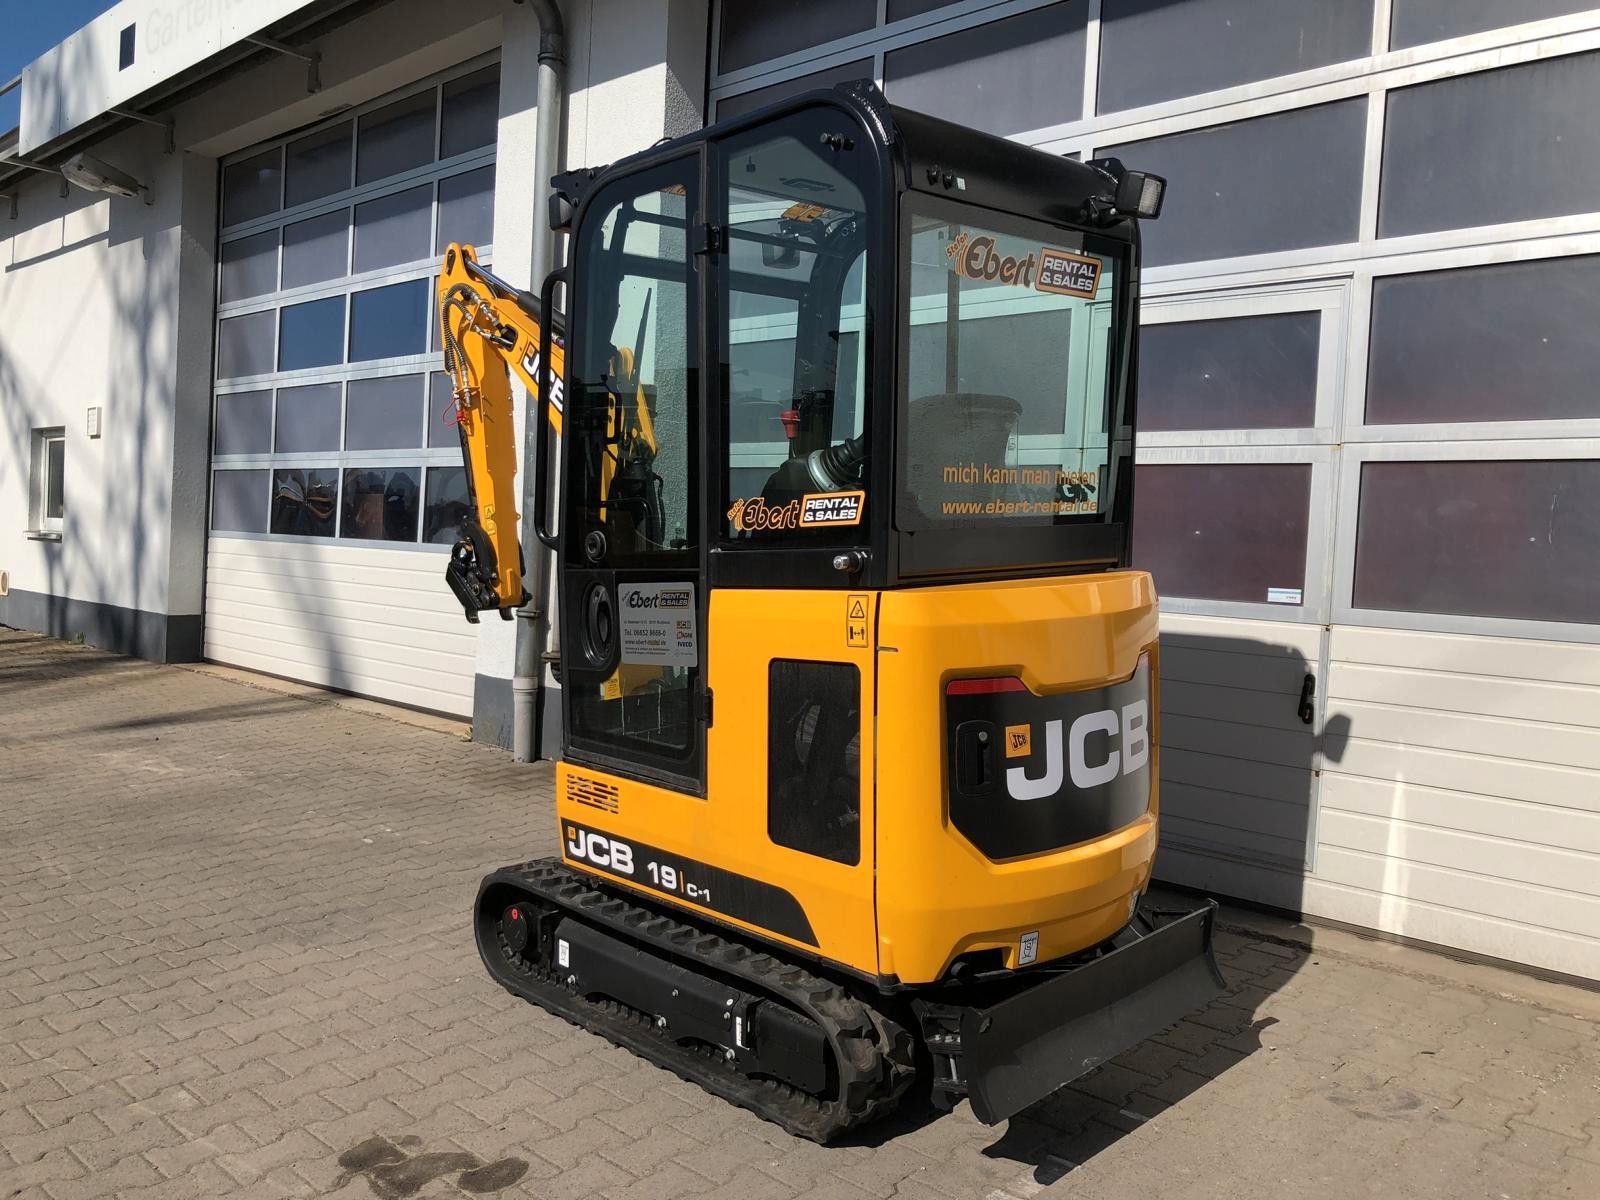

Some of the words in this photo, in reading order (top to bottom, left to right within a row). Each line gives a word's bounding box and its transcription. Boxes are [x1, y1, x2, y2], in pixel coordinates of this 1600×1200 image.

[145, 0, 242, 55] Garten
[964, 235, 1037, 288] Ebert
[1043, 257, 1096, 278] RENTAL
[1040, 272, 1052, 284] &
[1052, 274, 1095, 291] SALES
[943, 462, 979, 483] mich
[983, 463, 1017, 484] kann
[1021, 469, 1050, 485] man
[741, 497, 800, 531] Ebert
[806, 497, 859, 510] RENTAL
[942, 499, 1098, 514] www.ebert-rental.de
[804, 511, 815, 522] &
[815, 509, 857, 521] SALES
[629, 590, 660, 608] Ebert
[1006, 699, 1149, 800] JCB
[1012, 732, 1027, 749] JCB
[569, 829, 635, 875] JCB
[647, 861, 677, 890] 19
